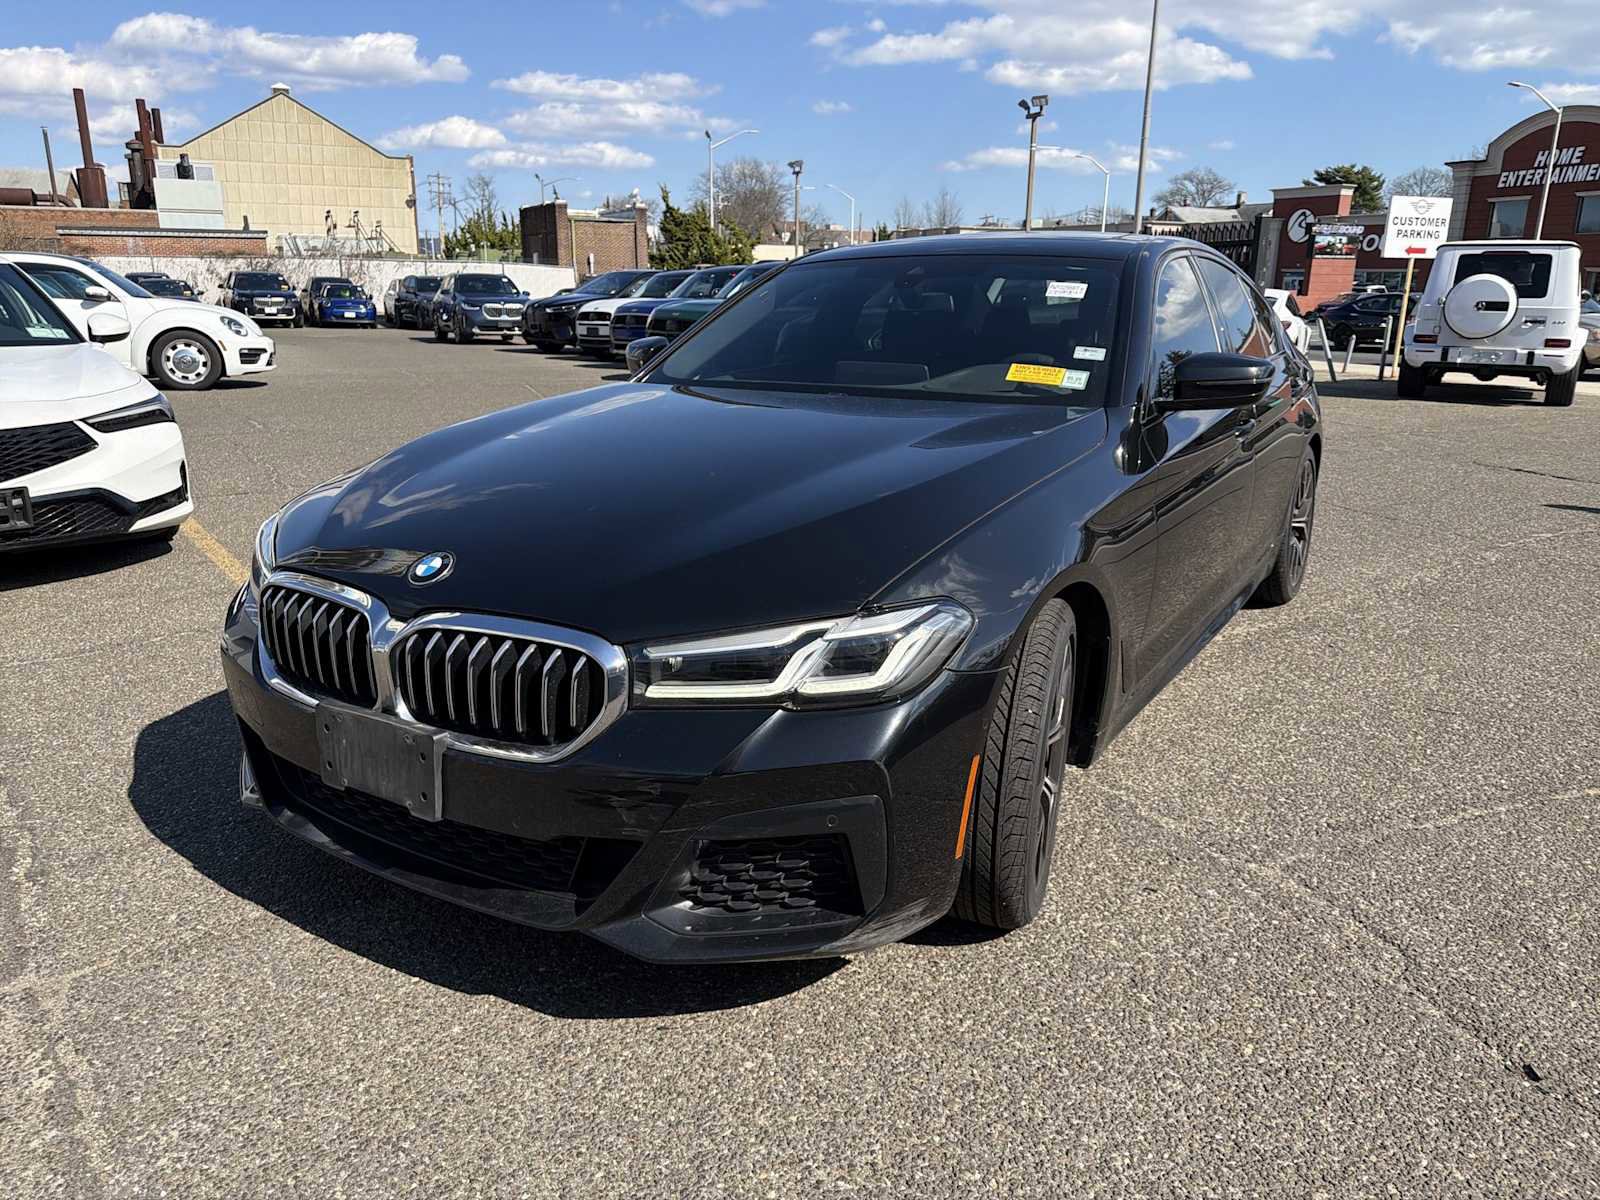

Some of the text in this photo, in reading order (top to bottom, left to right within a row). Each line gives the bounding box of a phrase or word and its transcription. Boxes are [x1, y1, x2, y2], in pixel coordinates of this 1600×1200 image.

[1534, 146, 1586, 167] HOME
[1392, 216, 1447, 227] CUSTOMER
[1396, 229, 1441, 240] PARKING
